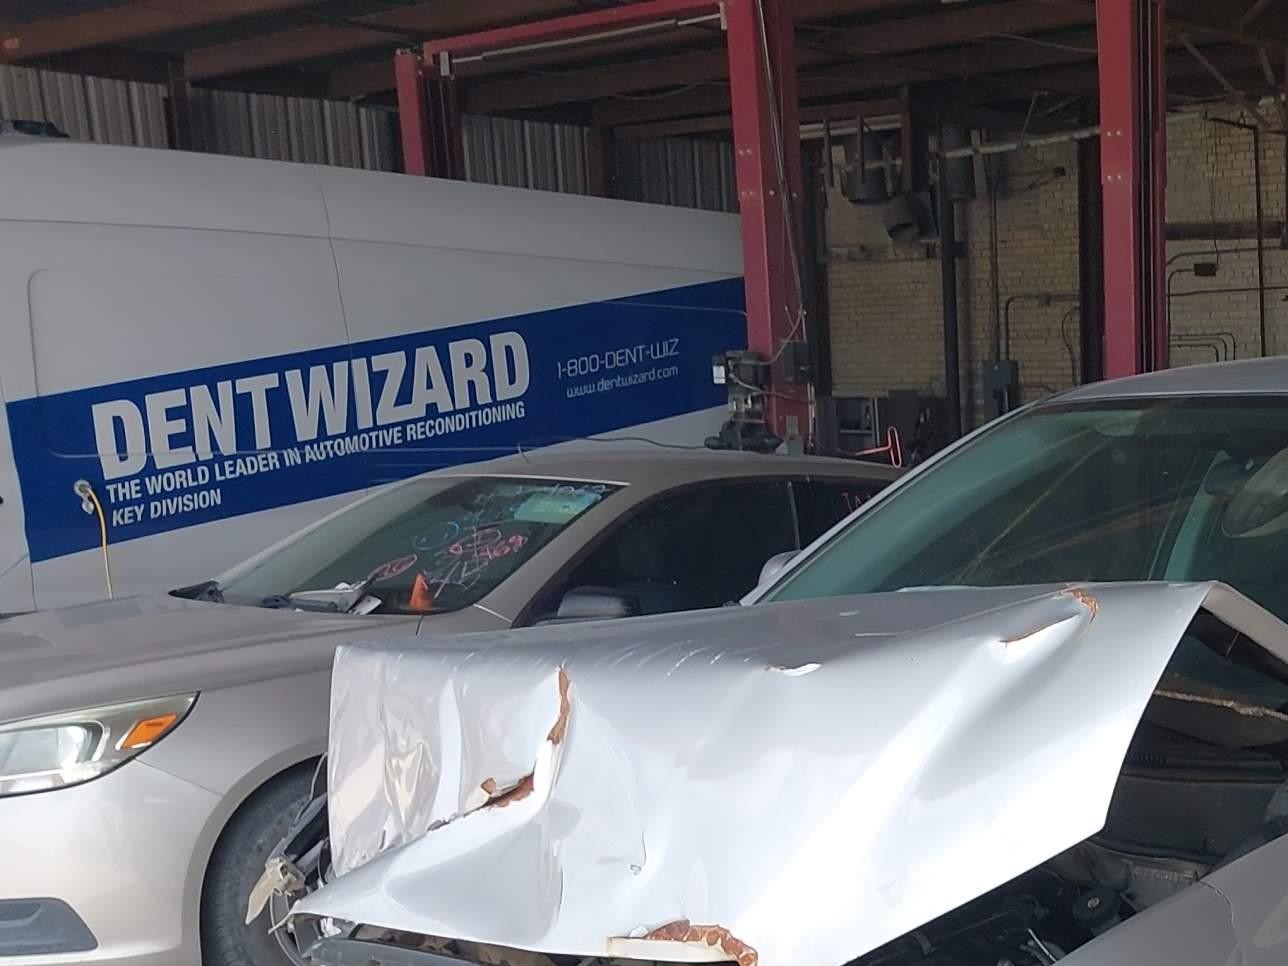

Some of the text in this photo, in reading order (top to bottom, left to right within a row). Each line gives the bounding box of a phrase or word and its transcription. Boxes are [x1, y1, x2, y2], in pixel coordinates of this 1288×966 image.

[557, 338, 679, 379] 1-800-DENT-WIZ
[566, 365, 679, 398] www.dentwizard.com
[92, 331, 530, 480] DENT WIZARD
[106, 401, 526, 503] THE WORLD LEADER IN AUTOMOTIVE RECONDITIONING
[112, 488, 222, 526] KEY DIVISION
